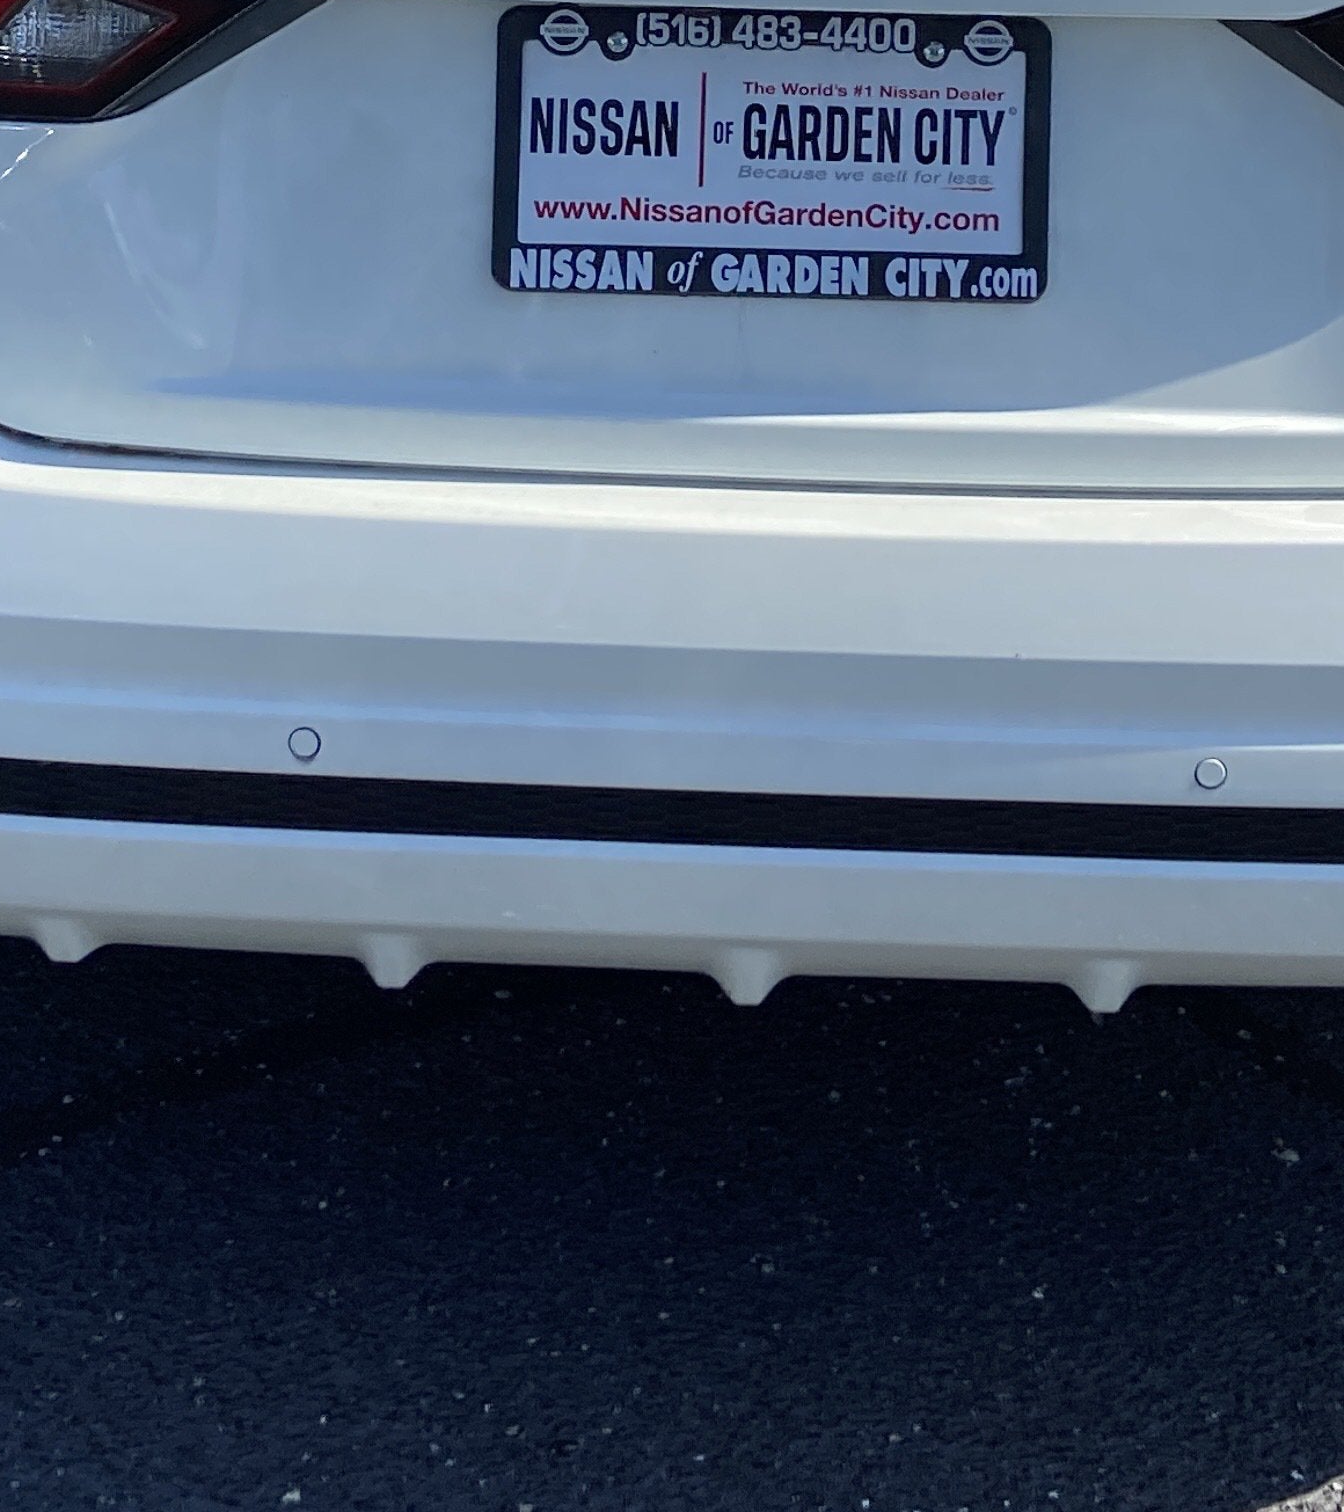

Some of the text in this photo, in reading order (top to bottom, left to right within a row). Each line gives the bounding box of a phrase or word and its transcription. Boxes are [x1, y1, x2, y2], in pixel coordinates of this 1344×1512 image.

[635, 12, 916, 53] (516) 483-4400
[743, 81, 1004, 101] The World's #1 Nissan Dealer
[530, 97, 1005, 166] NISSAN OF GARDEN CITY
[738, 165, 828, 181] Because
[834, 170, 865, 182] we
[871, 168, 908, 183] sell
[913, 169, 942, 184] for
[533, 196, 1000, 234] www.NissanofGardenCity.com
[509, 247, 1038, 298] NISSAN of GARDEN CITY.com
